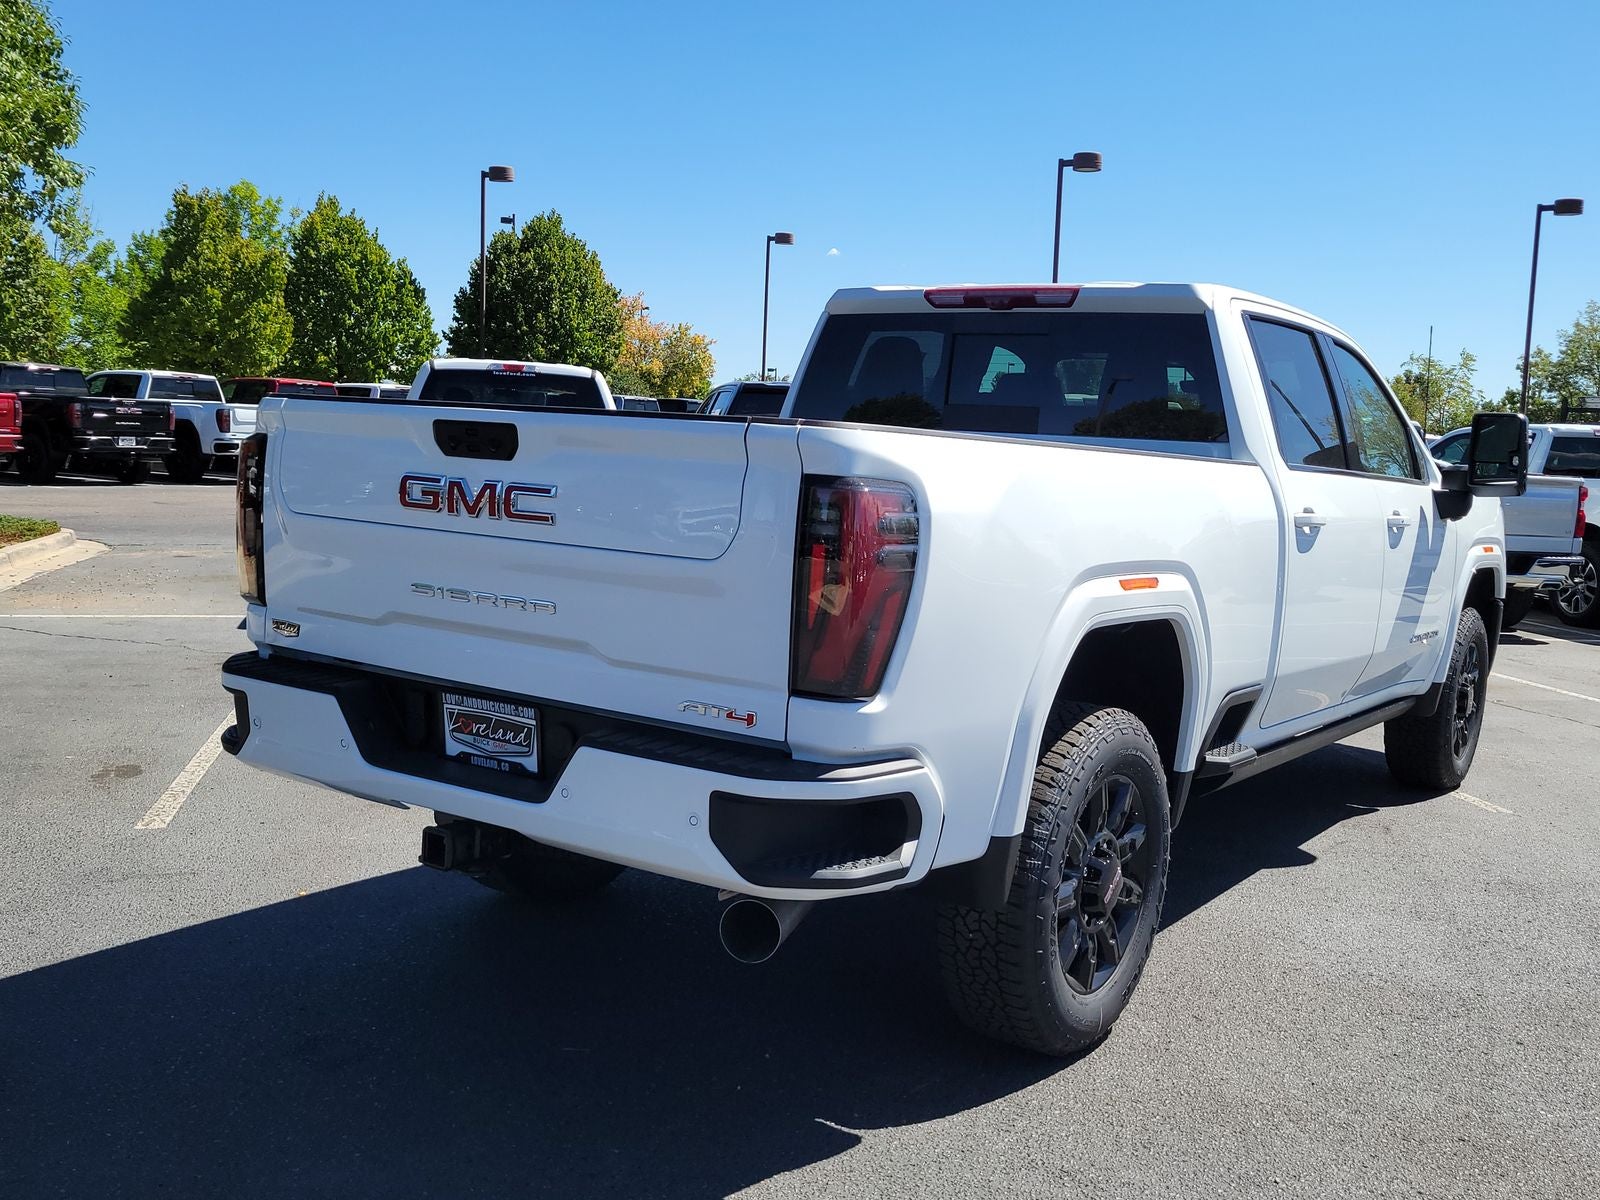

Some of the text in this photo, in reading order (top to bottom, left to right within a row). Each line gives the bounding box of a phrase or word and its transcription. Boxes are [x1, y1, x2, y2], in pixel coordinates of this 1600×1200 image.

[399, 472, 558, 526] GMC
[410, 582, 557, 615] SIERRA
[442, 692, 535, 719] LOVELANDBUICKGMC.COM
[677, 699, 757, 729] AT4
